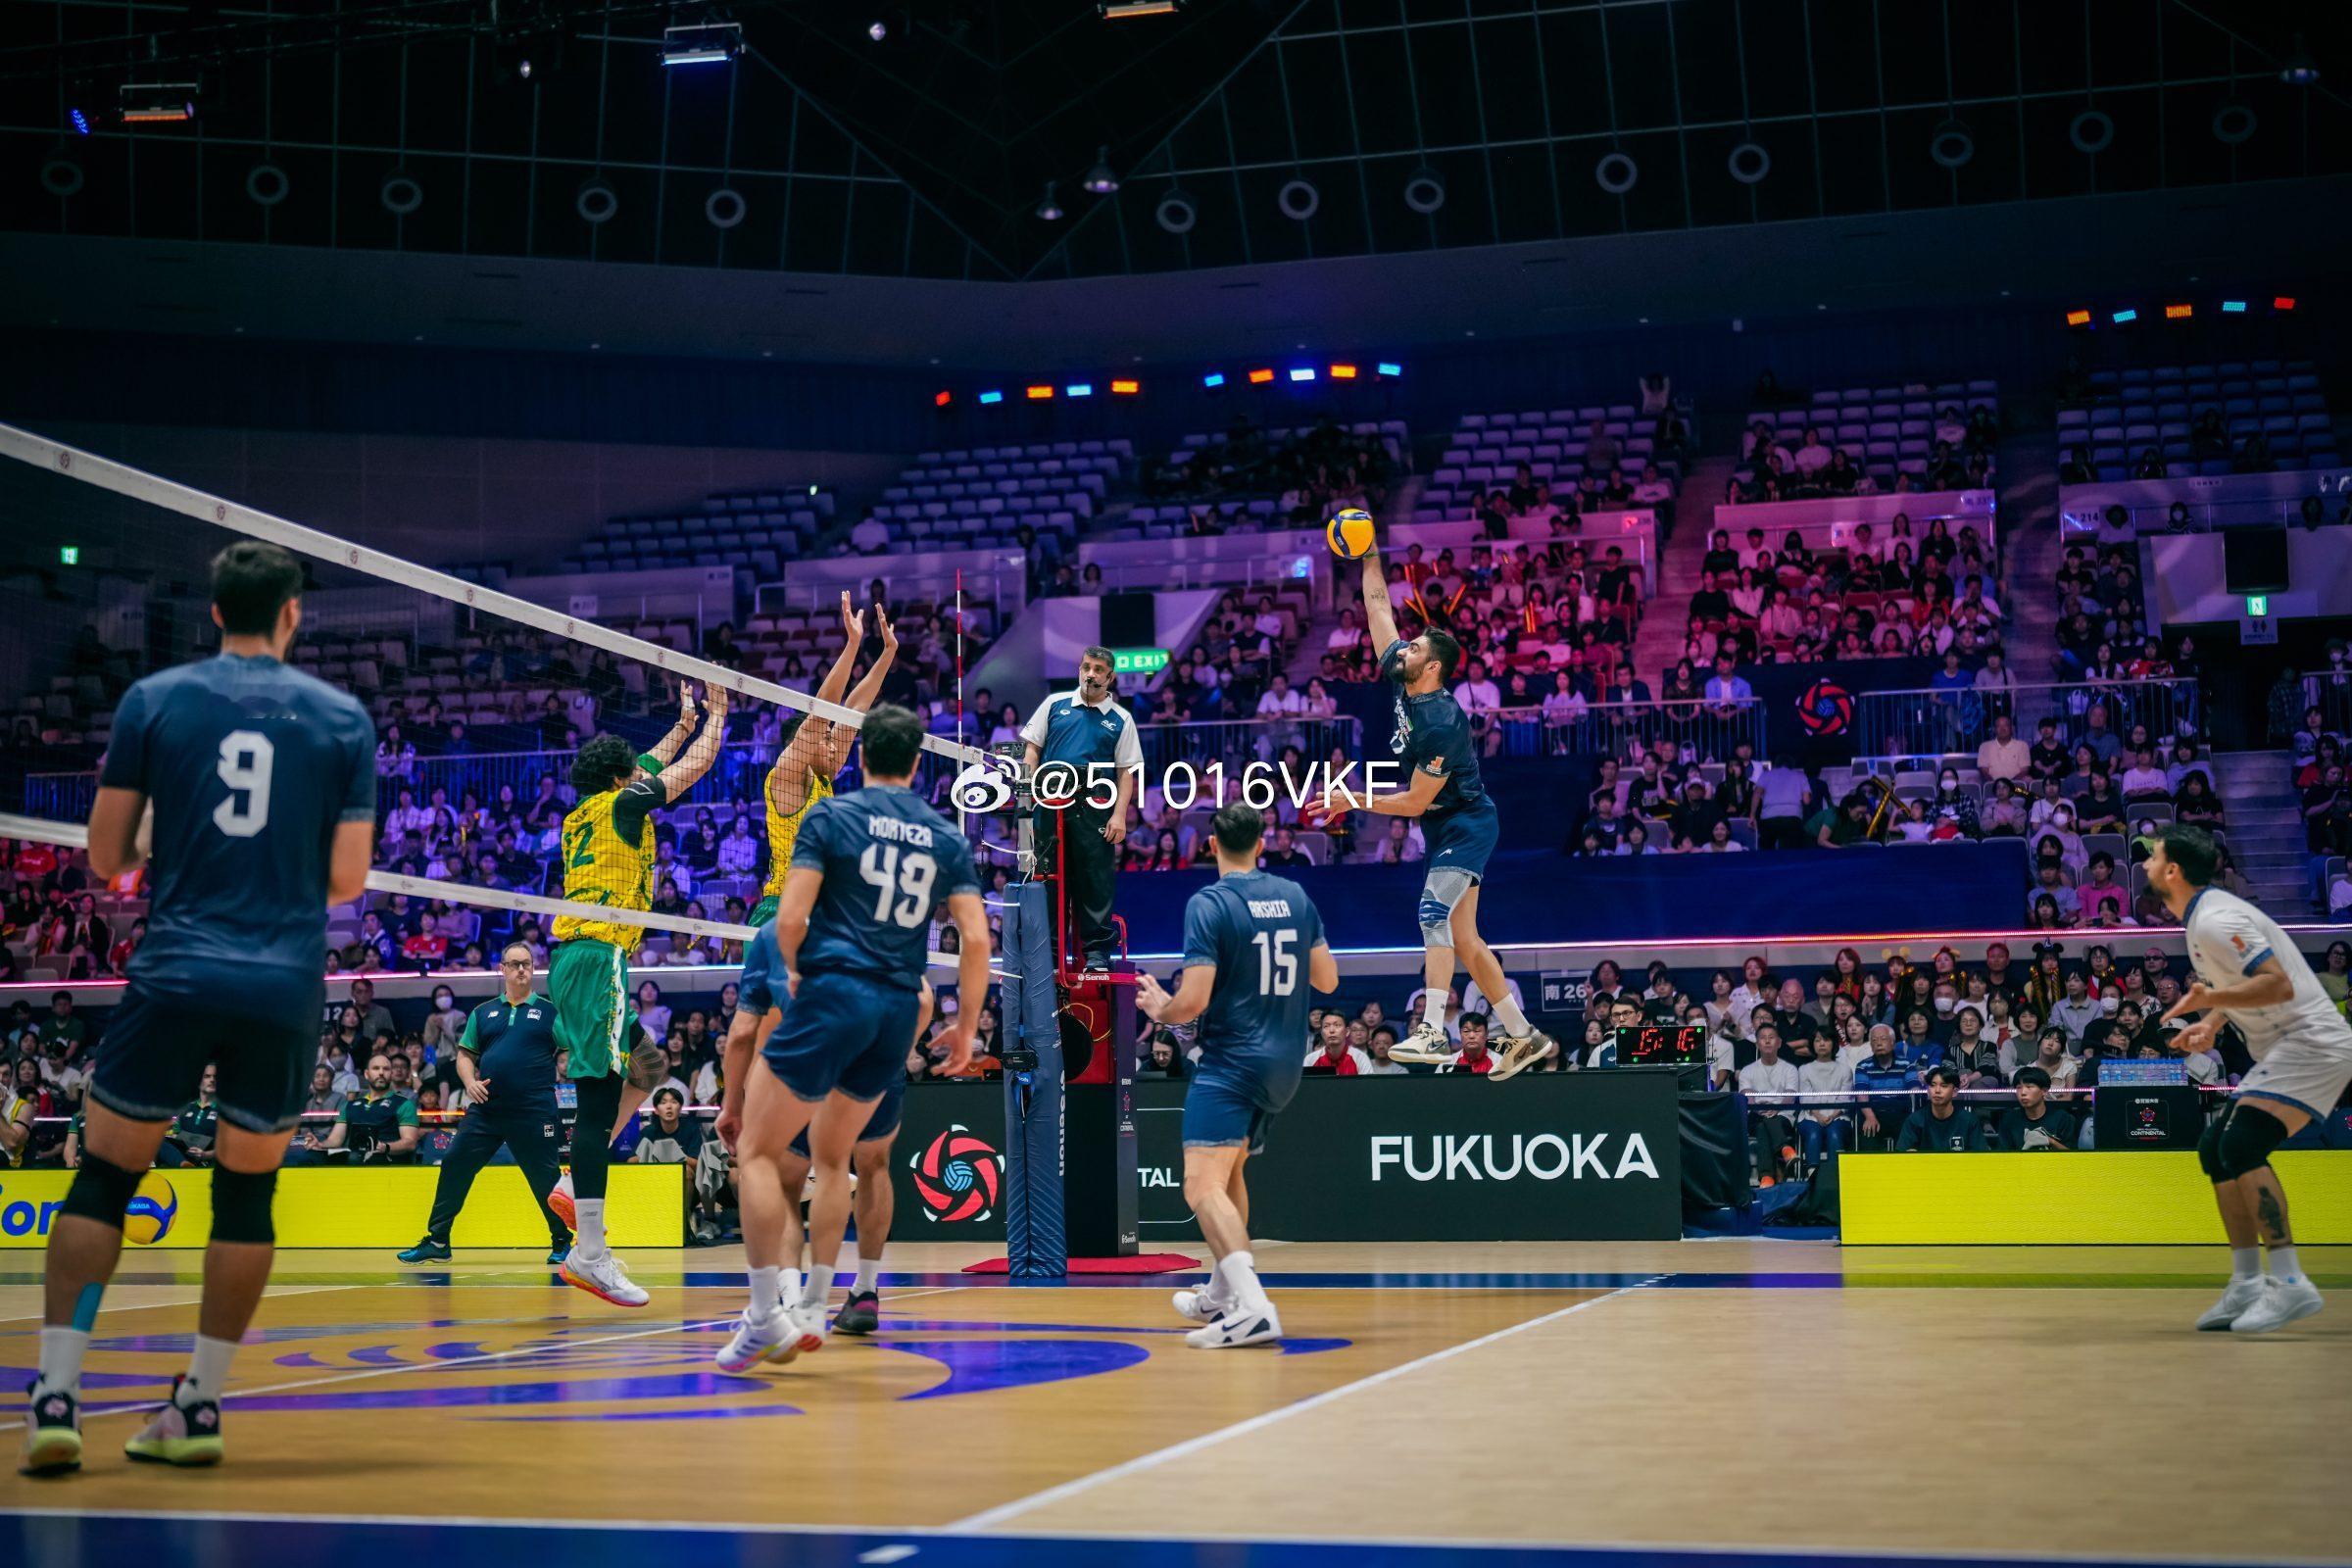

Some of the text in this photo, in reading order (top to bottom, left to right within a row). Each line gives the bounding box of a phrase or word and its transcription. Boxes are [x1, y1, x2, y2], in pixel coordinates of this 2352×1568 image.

[213, 729, 274, 838] 9
[868, 814, 933, 849] MORTEZA
[858, 843, 938, 929] 49
[1247, 900, 1292, 918] ARSHIA
[1251, 928, 1298, 997] 15
[1544, 985, 1560, 1001] 南
[1137, 1167, 1181, 1188] TAL
[1371, 1133, 1660, 1182] FUKUOKA
